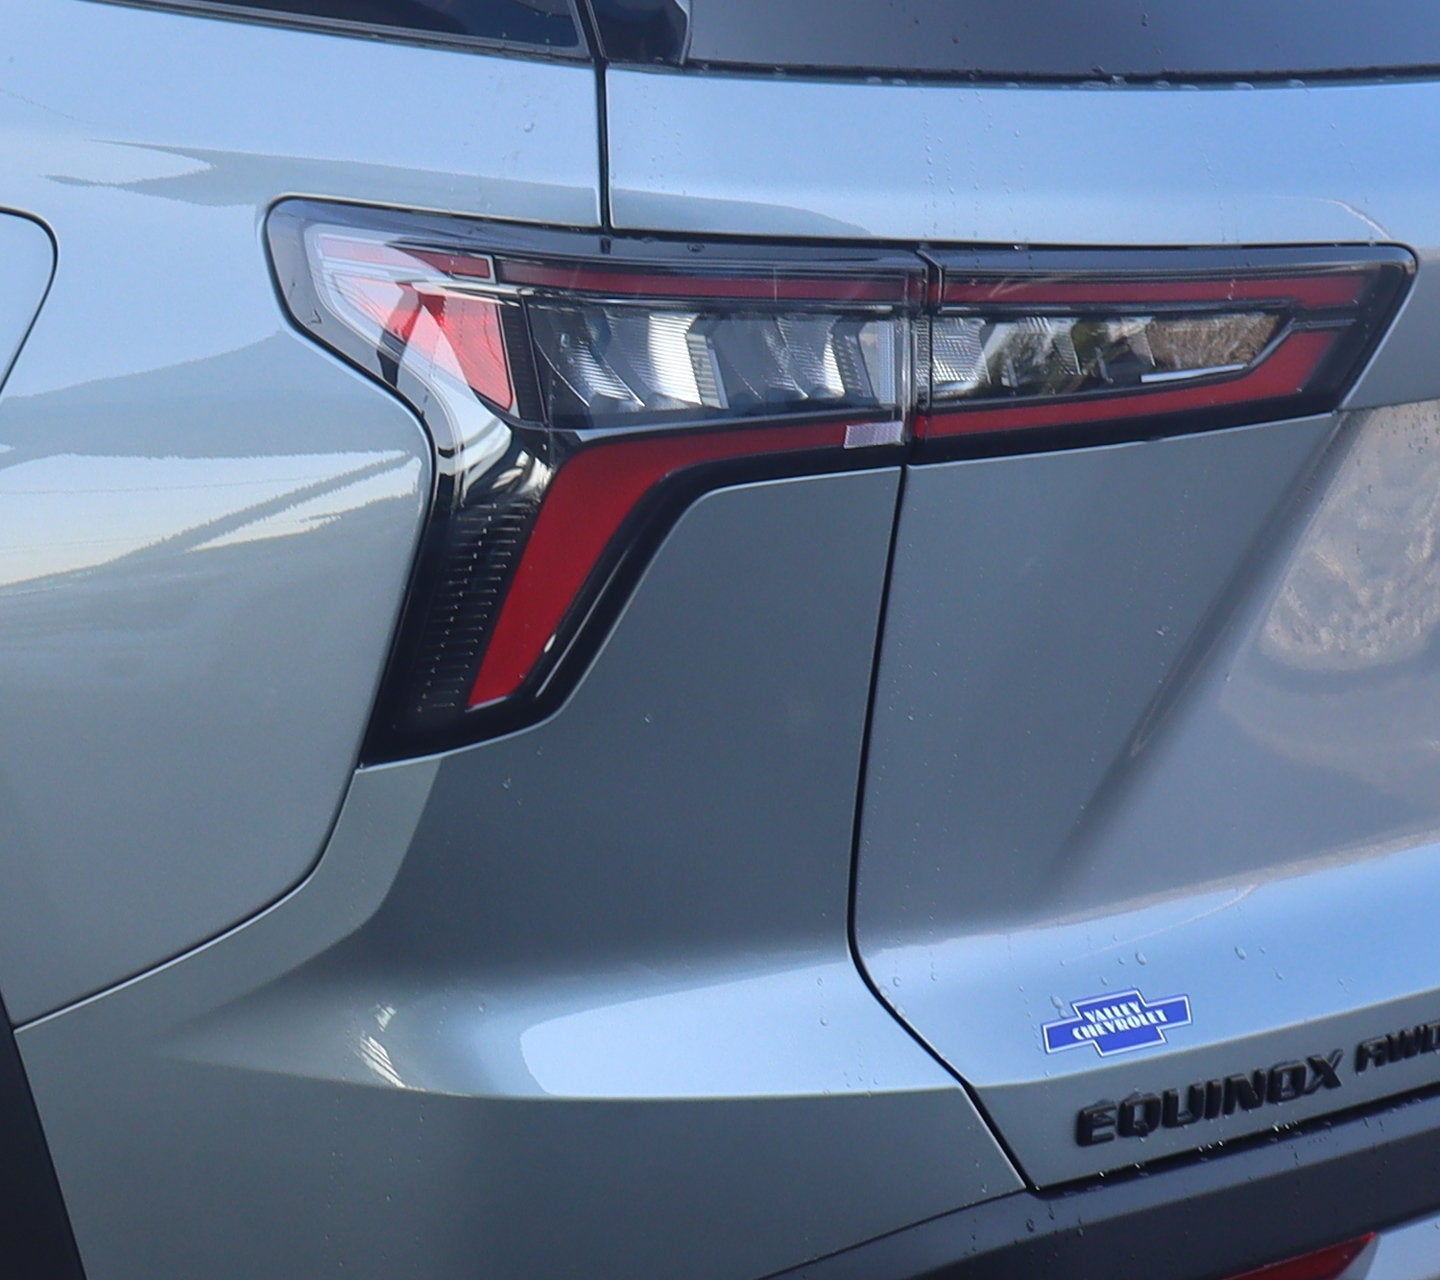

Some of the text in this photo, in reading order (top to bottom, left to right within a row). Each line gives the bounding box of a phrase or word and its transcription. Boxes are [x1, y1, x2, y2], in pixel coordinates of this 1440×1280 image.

[1072, 1009, 1168, 1040] CHEVROLET
[1083, 1001, 1141, 1023] VALLEY
[1076, 1049, 1344, 1146] EQUINOX
